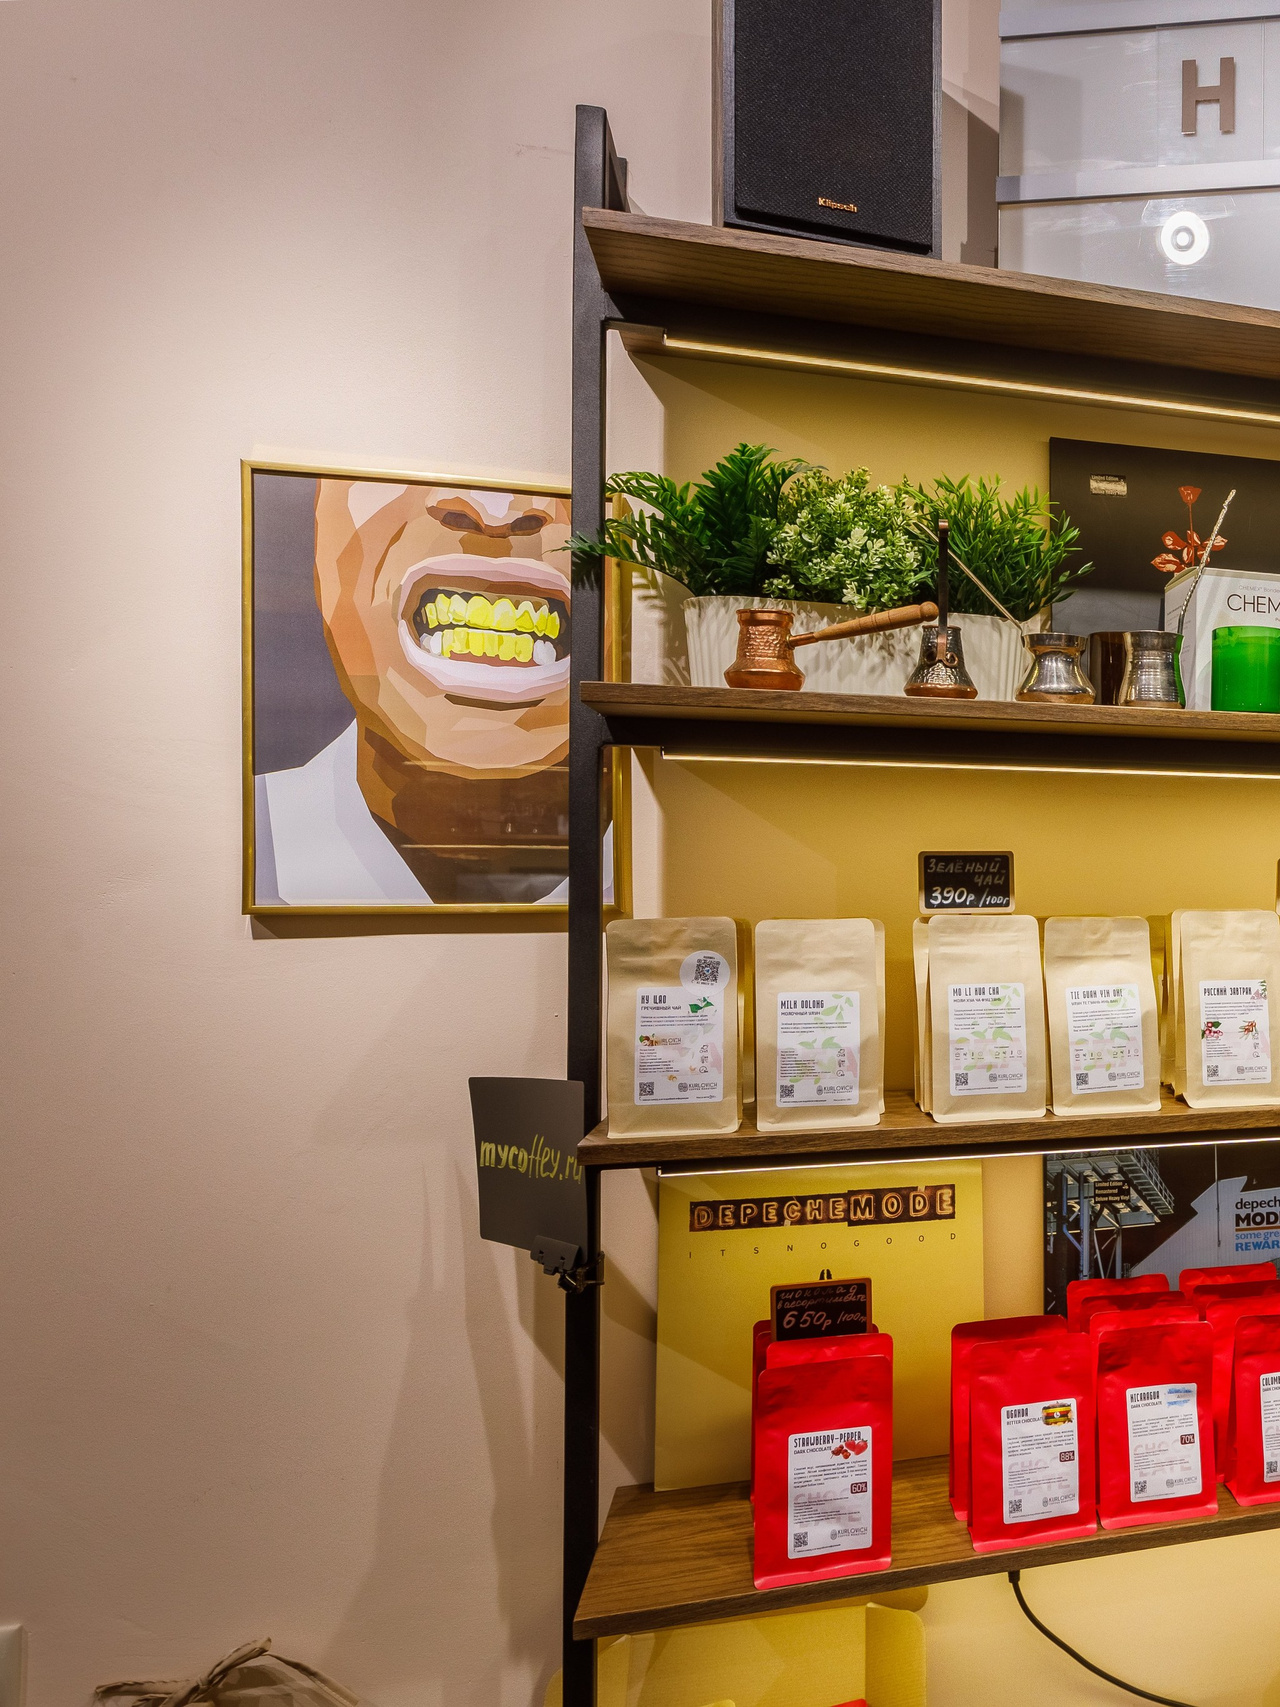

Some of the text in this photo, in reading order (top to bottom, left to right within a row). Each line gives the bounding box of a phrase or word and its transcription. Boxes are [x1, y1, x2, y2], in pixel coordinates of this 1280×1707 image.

[818, 197, 858, 212] Klipsch
[953, 988, 962, 996] MO
[964, 988, 972, 996] LI
[974, 987, 986, 996] HUA
[1070, 991, 1080, 999] TIE
[1083, 990, 1097, 999] GUAN
[1100, 989, 1111, 998] YIN
[1203, 986, 1252, 997] РУССКИЙ ЗАВТРАК
[781, 999, 824, 1009] MILK OOLONG
[1235, 1232, 1262, 1241] some
[1130, 1390, 1160, 1403] NICARAGUA
[1006, 1407, 1029, 1419] UGANDA
[1181, 1434, 1194, 1444] 70%
[806, 1445, 832, 1454] CHOCOLATE
[851, 1482, 868, 1493] 60%
[838, 1526, 868, 1535] KURLOVICH
